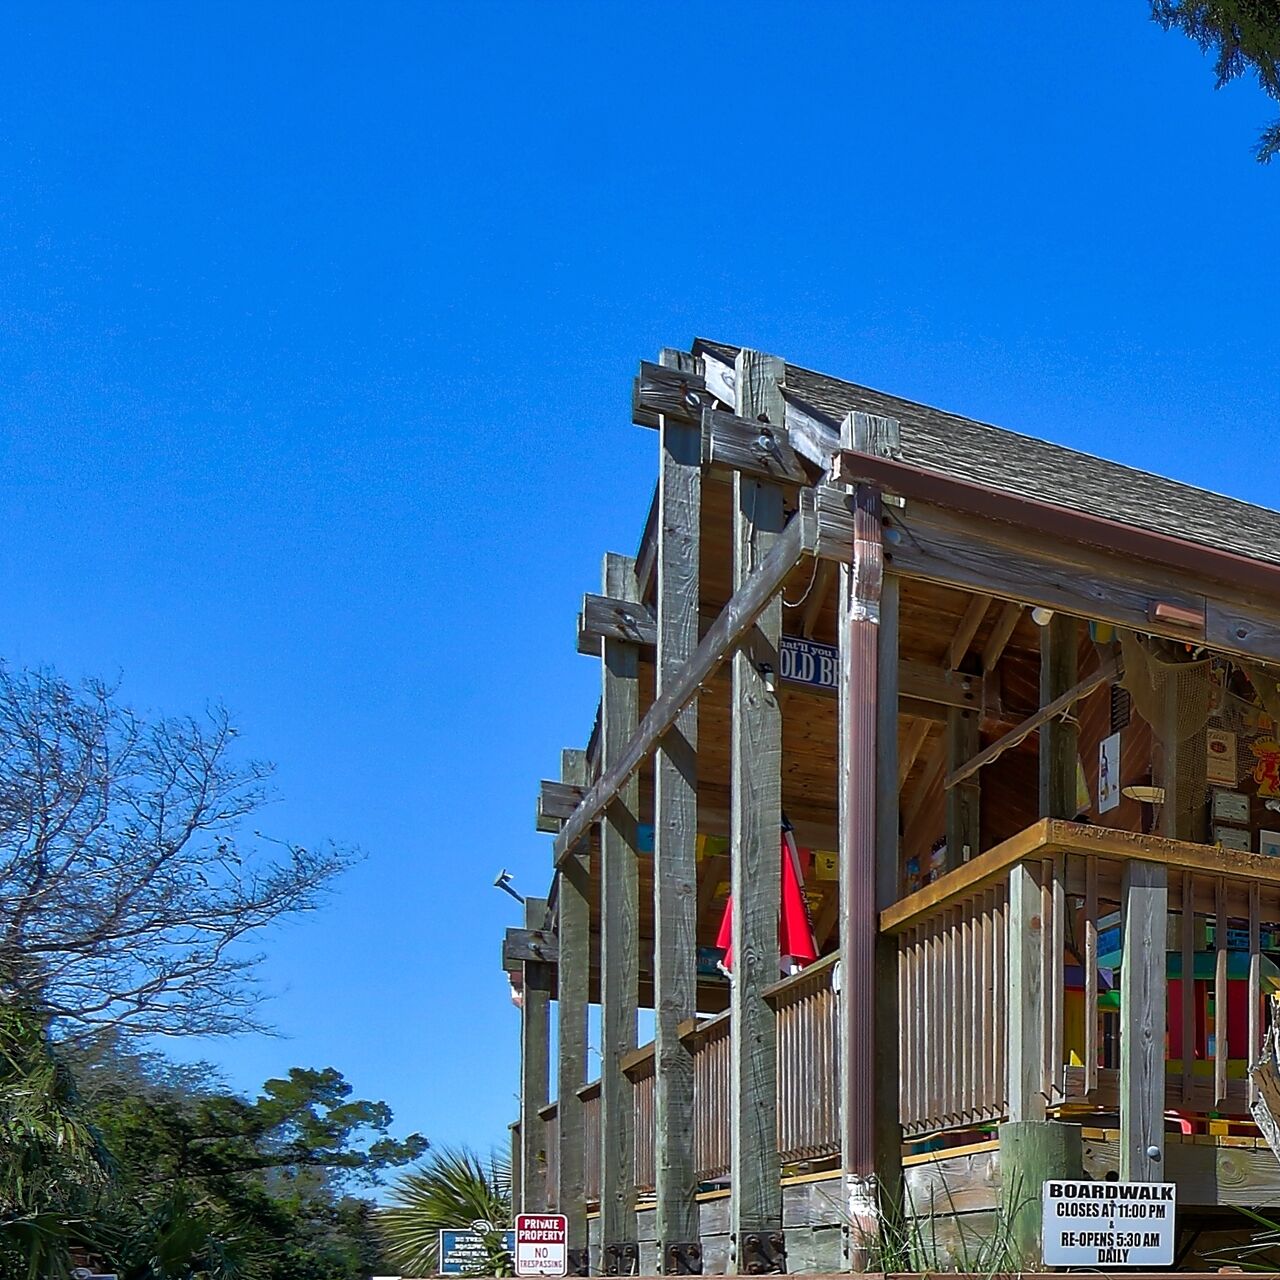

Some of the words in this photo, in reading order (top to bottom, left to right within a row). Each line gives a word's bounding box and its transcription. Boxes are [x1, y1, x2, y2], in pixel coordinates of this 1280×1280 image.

[780, 649, 816, 681] OLD
[1049, 1183, 1175, 1201] BOARDWALK
[1056, 1202, 1100, 1218] CLOSES
[1101, 1203, 1116, 1218] AT
[1118, 1203, 1147, 1219] 11:00
[1148, 1204, 1166, 1219] PM
[524, 1218, 560, 1230] PRIVATE
[1108, 1220, 1115, 1229] &
[518, 1230, 565, 1241] PROPERTY
[1061, 1231, 1115, 1247] RE-OPENS
[1116, 1232, 1141, 1247] 5:30
[1142, 1232, 1160, 1247] AM
[534, 1247, 549, 1259] NO
[1097, 1247, 1130, 1263] DAILY
[519, 1259, 563, 1268] TRESPASSING
